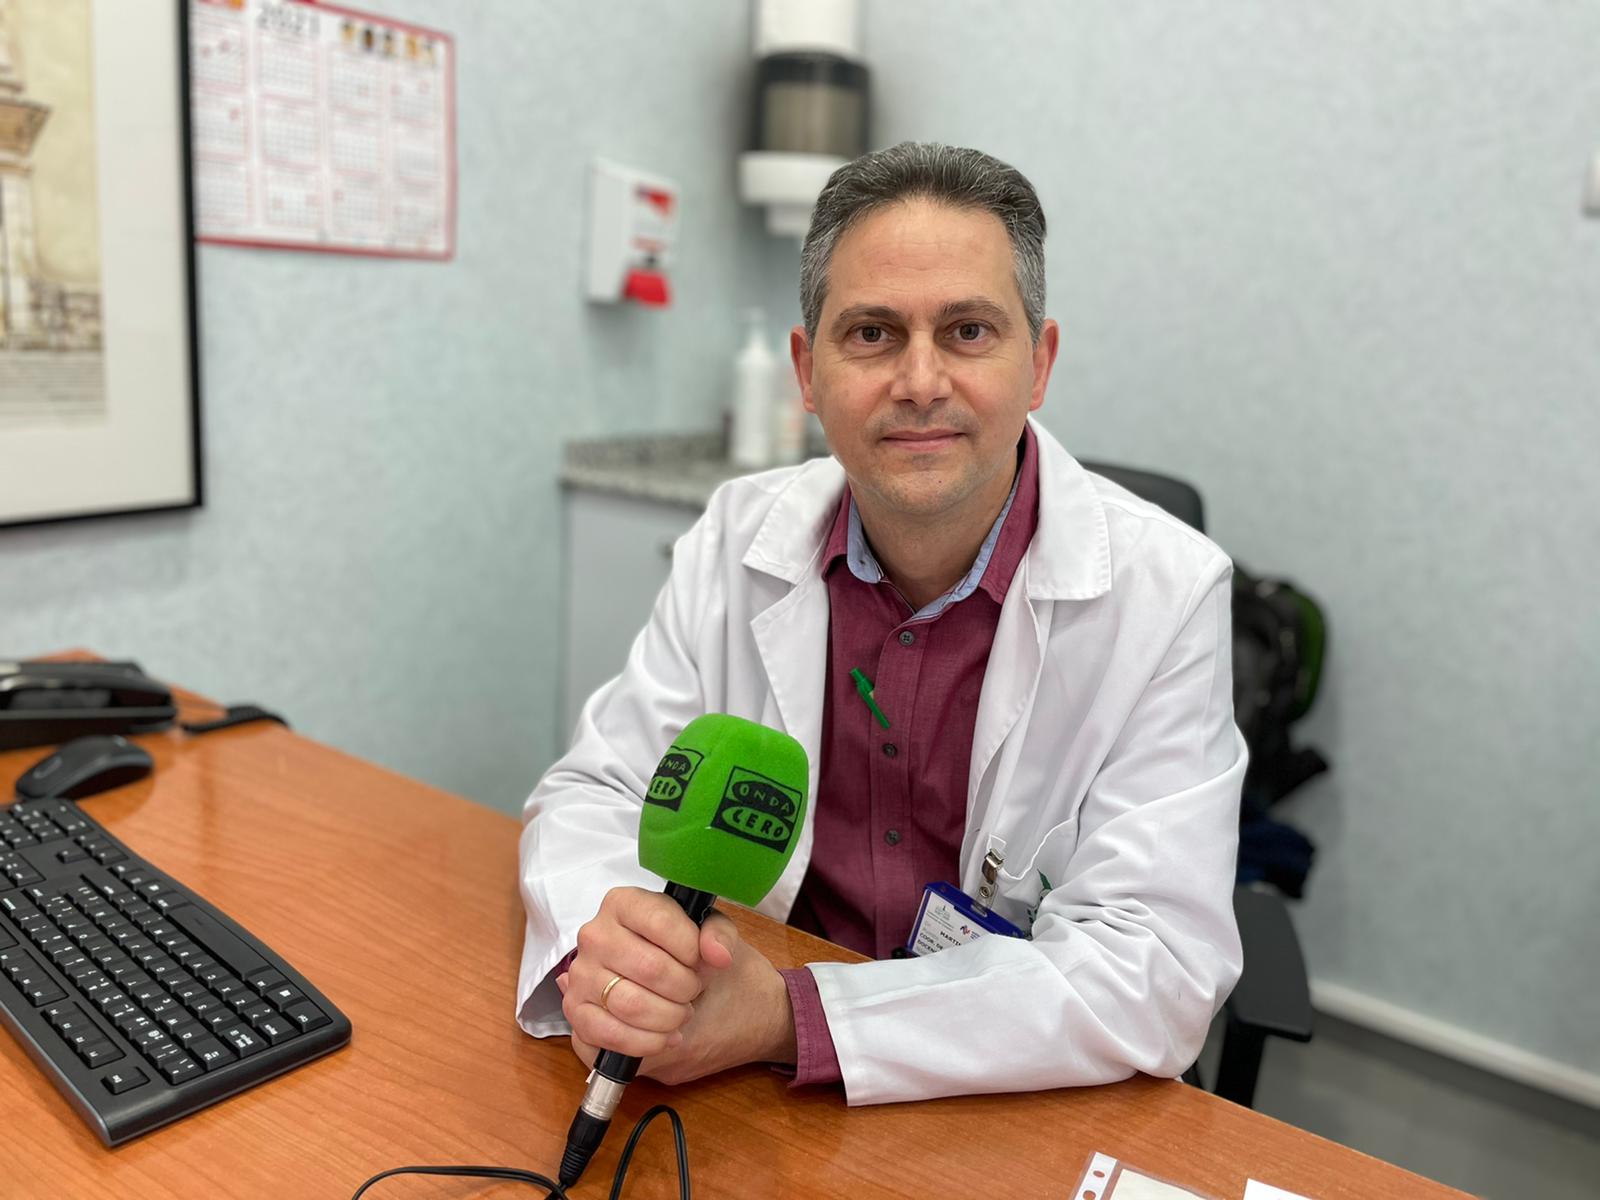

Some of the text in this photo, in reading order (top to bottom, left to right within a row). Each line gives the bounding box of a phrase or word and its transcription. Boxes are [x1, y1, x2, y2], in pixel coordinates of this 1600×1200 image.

[256, 1, 320, 34] 2021
[739, 783, 790, 812] ONDA
[732, 809, 784, 838] CERO
